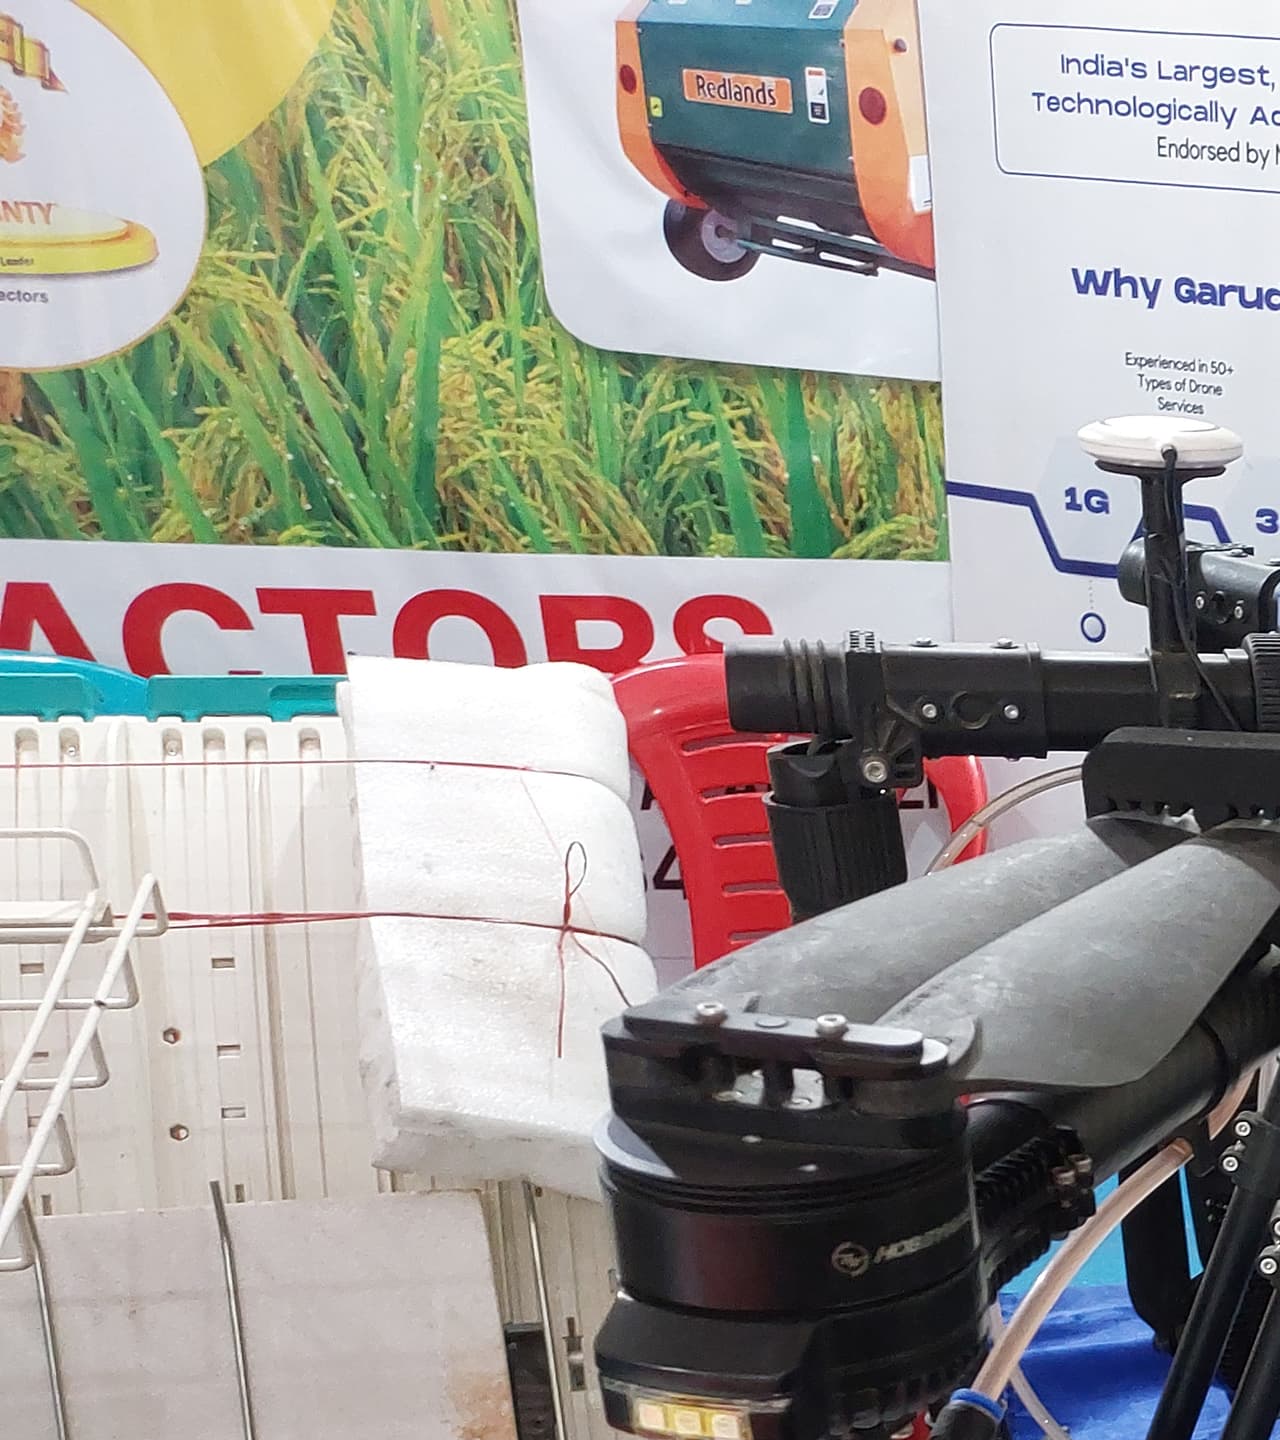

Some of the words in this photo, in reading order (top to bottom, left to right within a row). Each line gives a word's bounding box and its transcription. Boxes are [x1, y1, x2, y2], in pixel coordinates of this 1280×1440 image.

[1060, 54, 1148, 79] India's
[1157, 60, 1276, 91] Largest,
[696, 74, 777, 107] Redlands
[1032, 92, 1237, 130] Technologically
[1157, 136, 1240, 163] Endorsed
[1246, 142, 1270, 169] by
[0, 201, 56, 224] NTY
[1071, 267, 1162, 309] Why
[1125, 352, 1196, 372] Experienced
[1198, 359, 1208, 373] in
[1211, 360, 1234, 375] 50+
[1137, 373, 1172, 392] Types
[1174, 378, 1186, 391] of
[1189, 379, 1223, 396] Drone
[1158, 396, 1204, 415] Services
[1064, 486, 1110, 515] 1G
